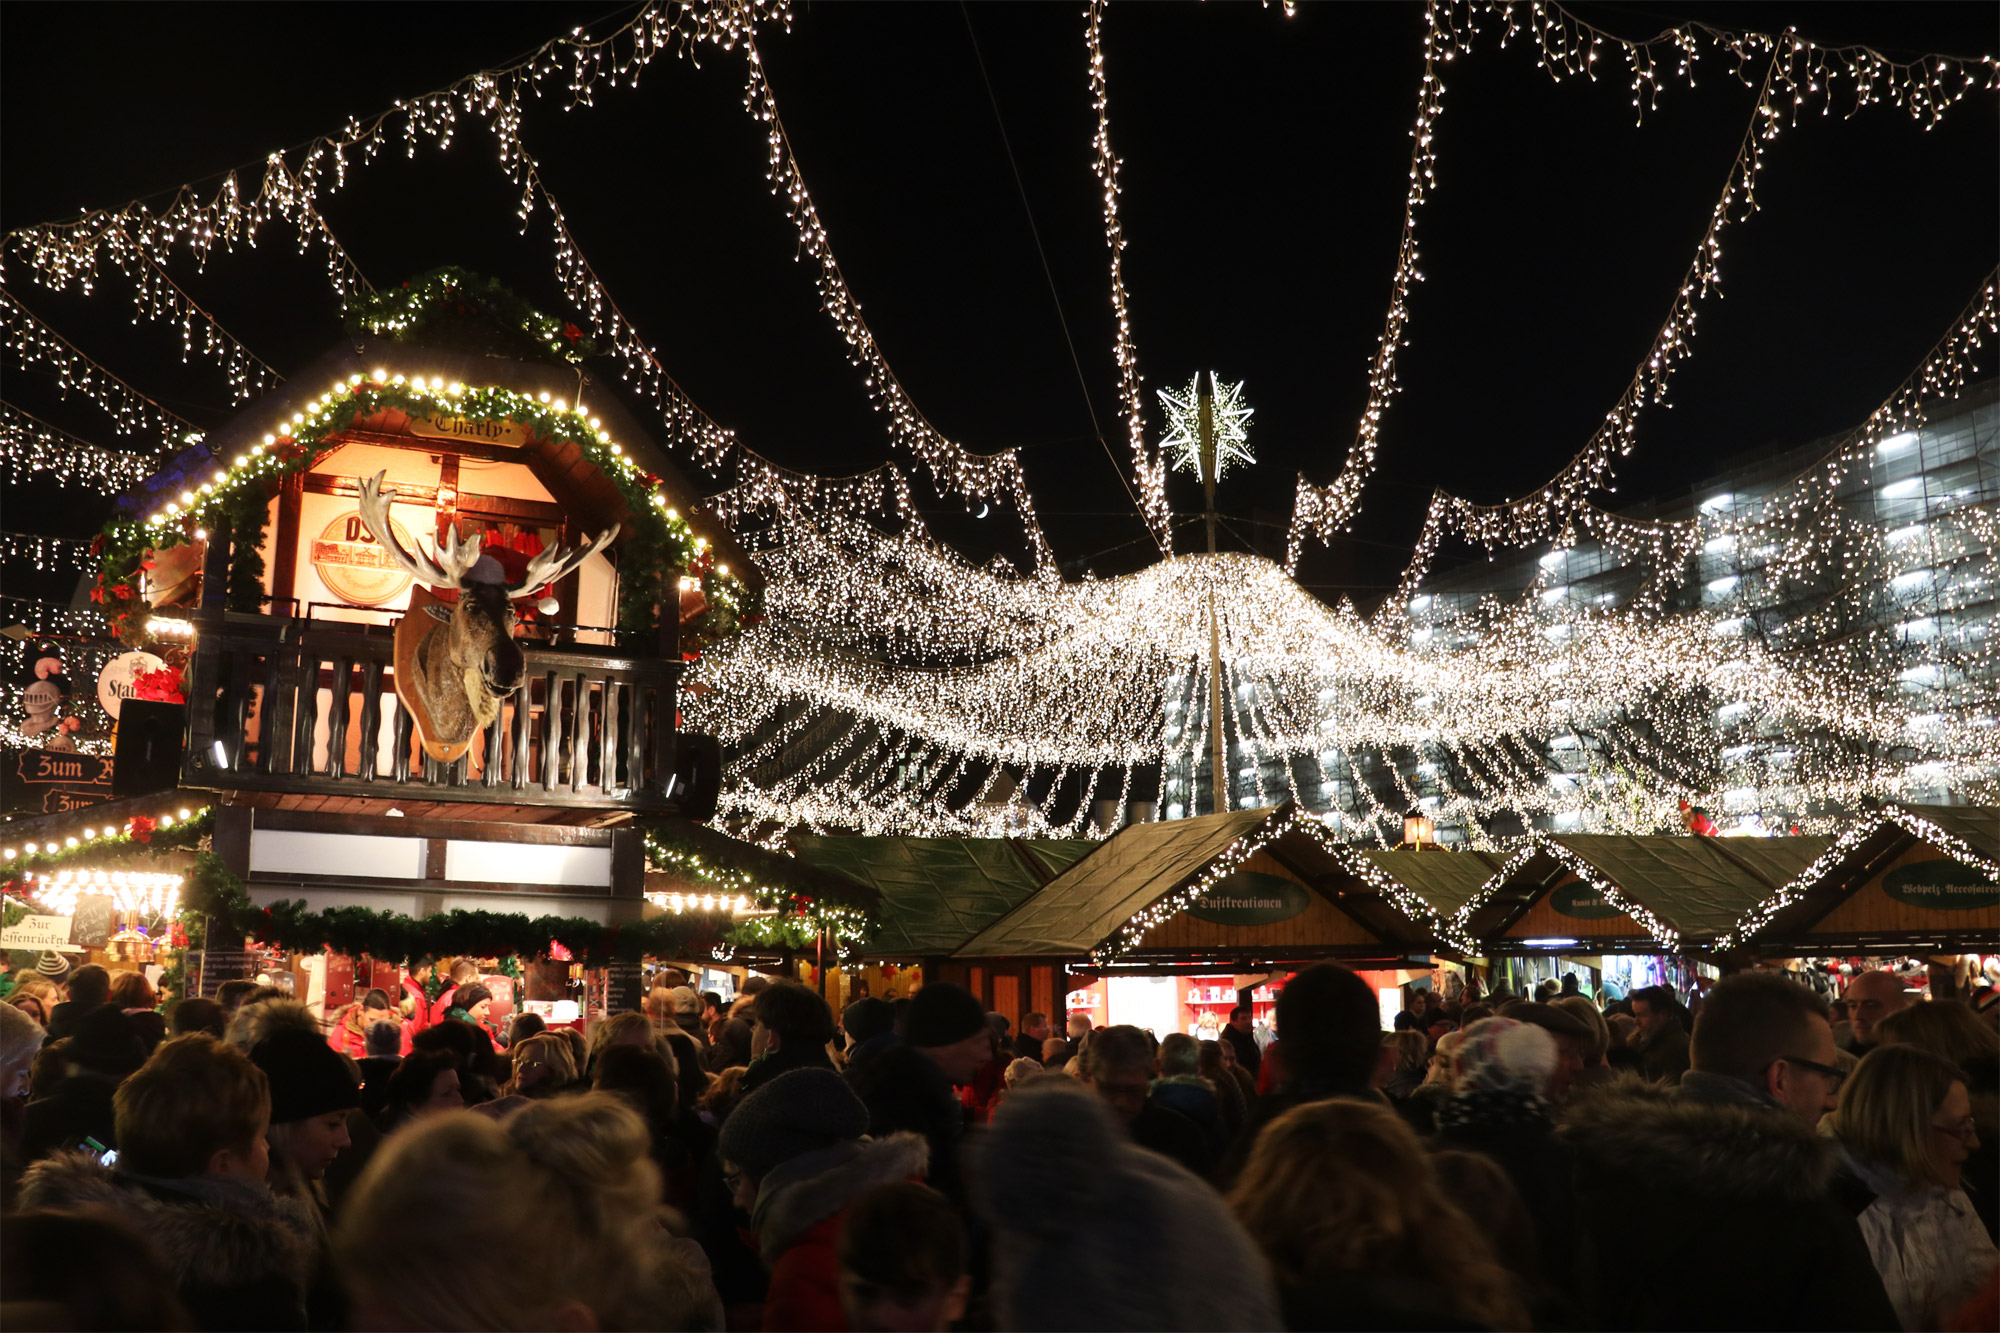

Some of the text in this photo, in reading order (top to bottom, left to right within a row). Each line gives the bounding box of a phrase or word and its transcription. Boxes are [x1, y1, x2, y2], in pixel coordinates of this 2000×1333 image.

[435, 416, 503, 441] Charly
[345, 516, 380, 544] DS
[37, 755, 82, 778] Zum
[29, 918, 51, 930] Zur
